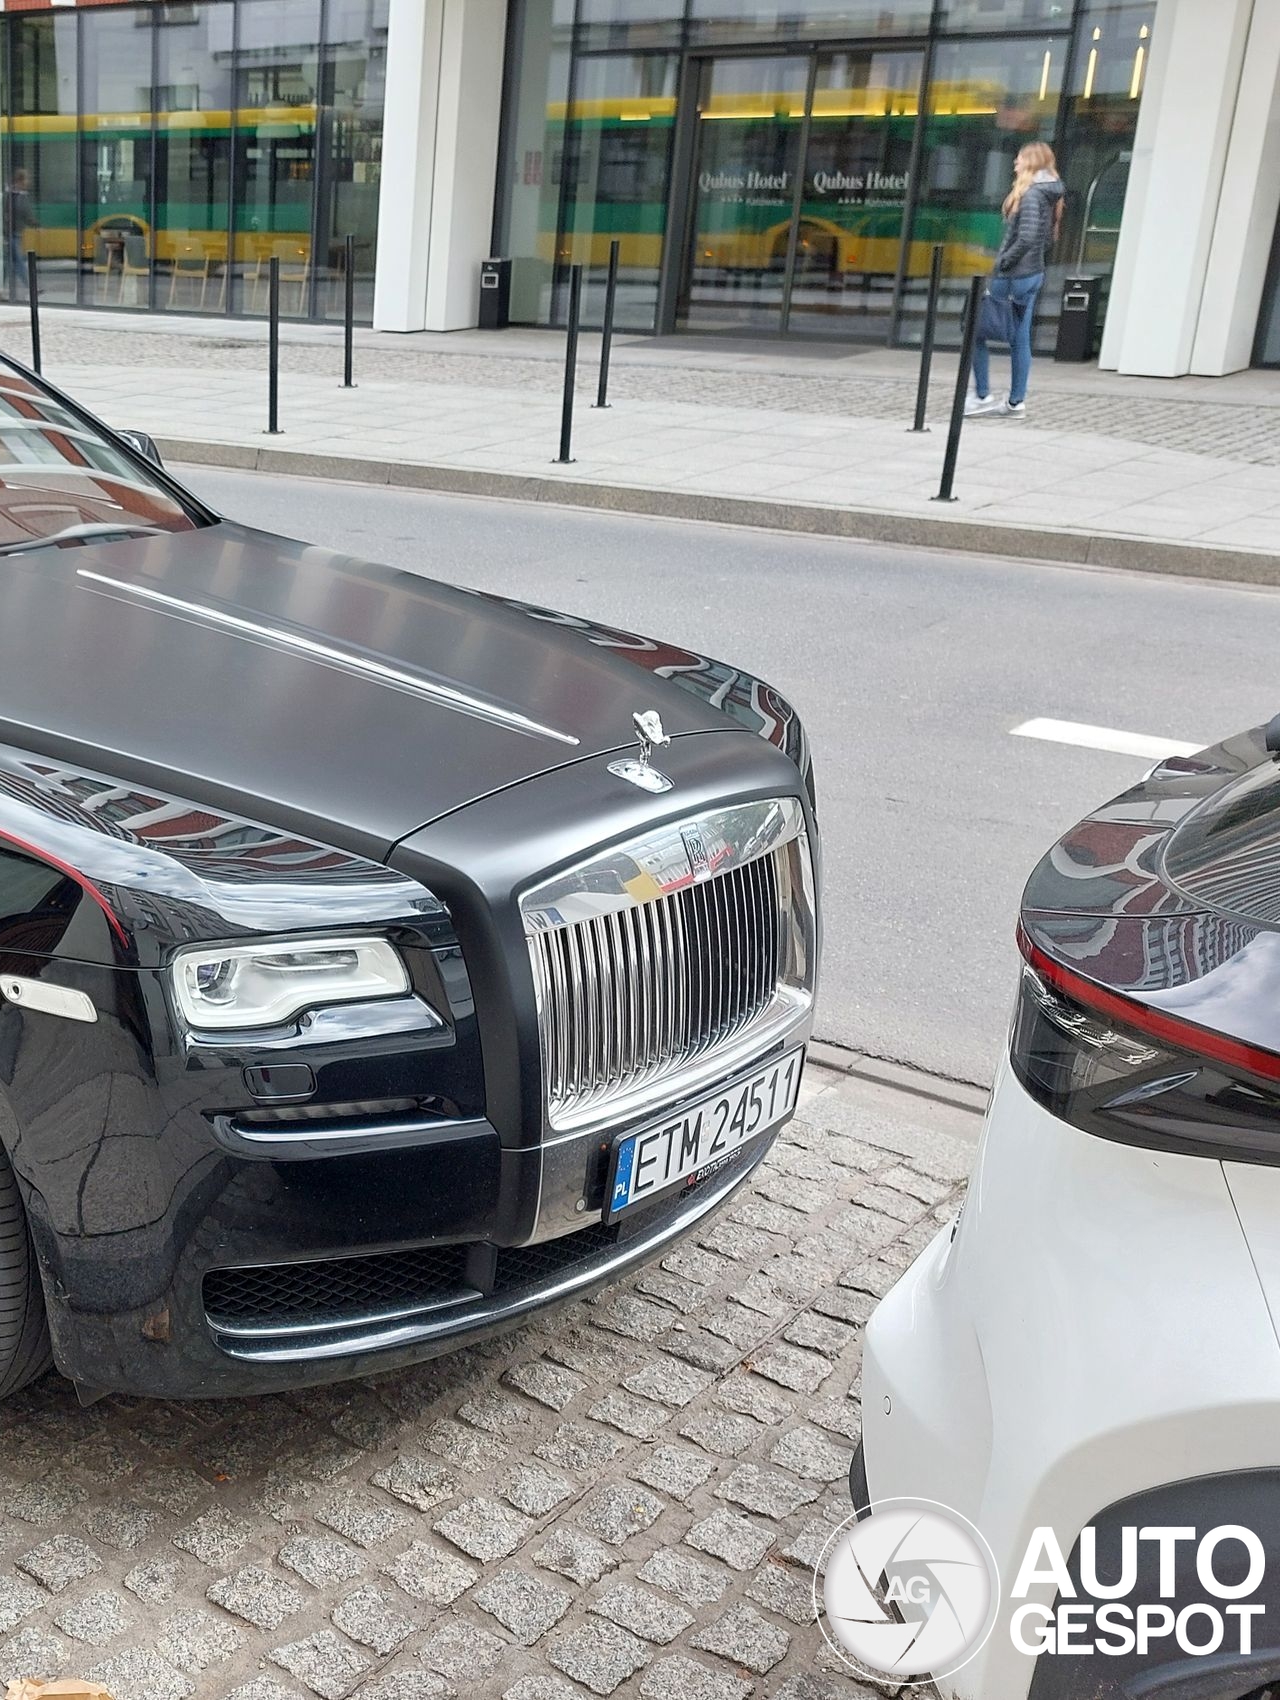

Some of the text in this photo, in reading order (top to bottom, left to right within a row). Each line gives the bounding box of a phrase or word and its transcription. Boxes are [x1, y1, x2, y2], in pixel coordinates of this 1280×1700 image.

[699, 170, 787, 192] Qubus Hotel
[813, 170, 910, 194] Qubus Hotel
[634, 1057, 796, 1195] ETM 24511
[614, 1183, 628, 1199] PL
